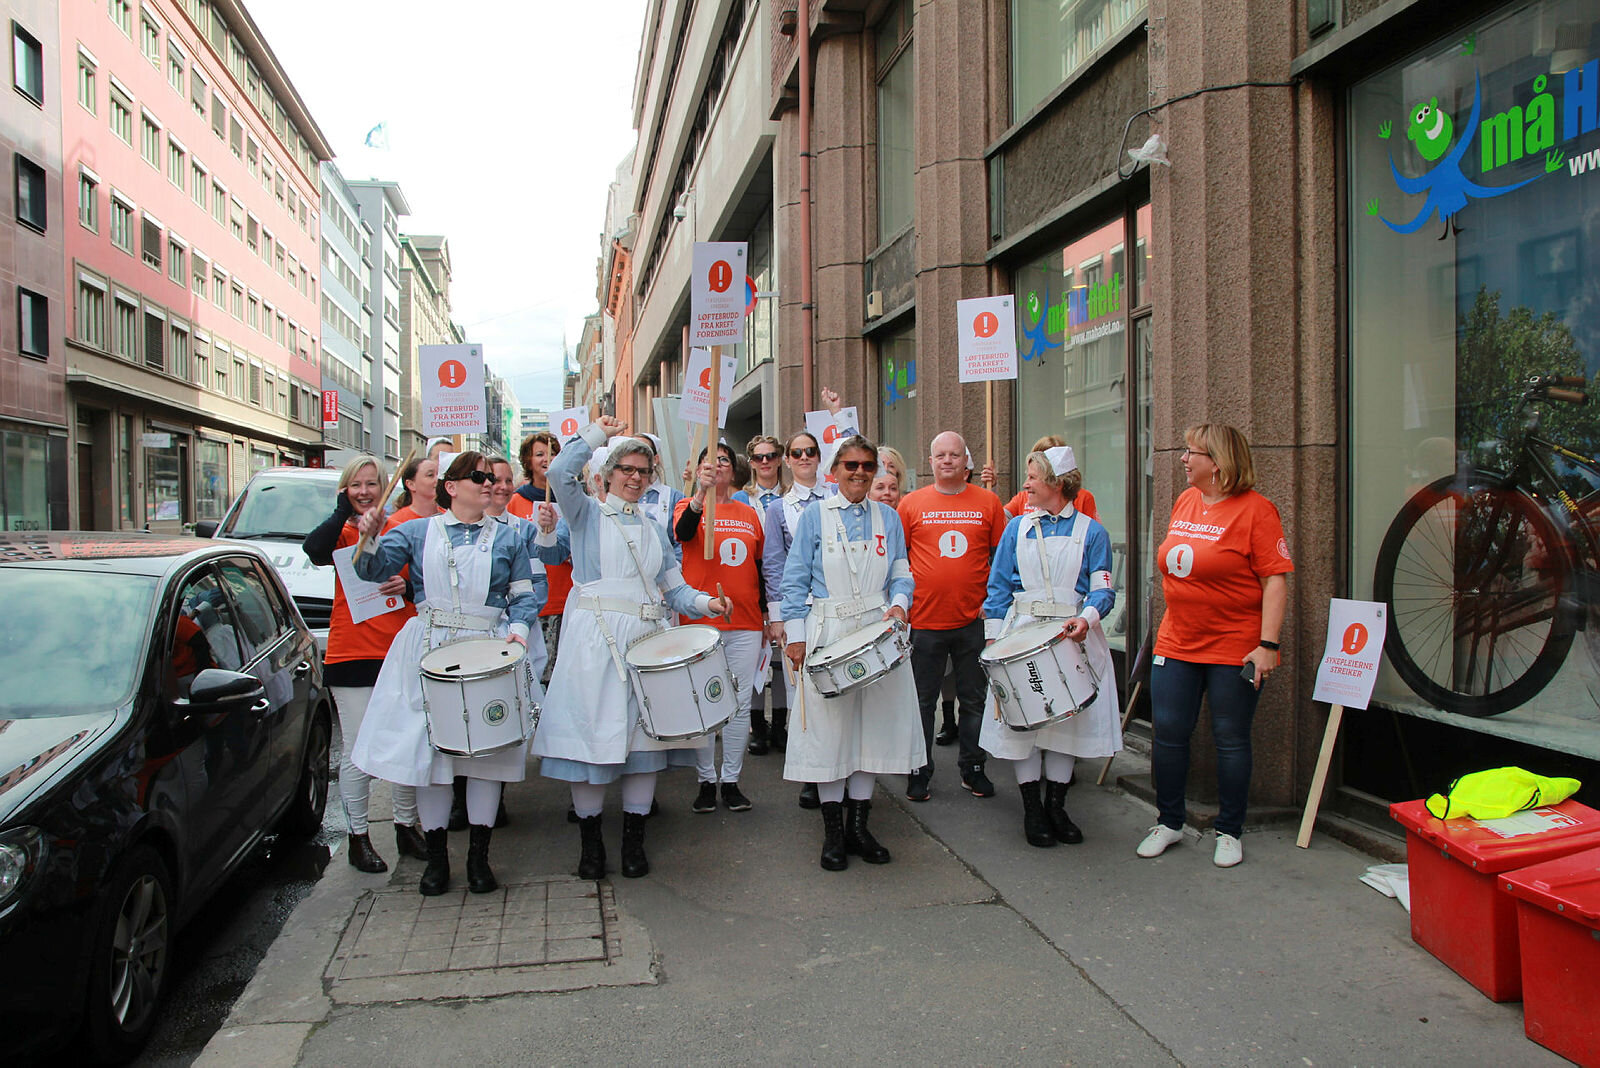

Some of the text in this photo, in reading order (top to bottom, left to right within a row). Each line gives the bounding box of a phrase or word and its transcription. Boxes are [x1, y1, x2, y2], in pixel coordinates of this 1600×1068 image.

[697, 311, 740, 321] LØFTEBRUDD
[700, 321, 714, 329] FRA
[696, 328, 738, 338] FORENINGEN
[965, 352, 1009, 362] LØFTEBRUDD
[968, 361, 982, 369] FRA
[965, 366, 1010, 375] FORENINGEN
[429, 404, 480, 414] LØFTEBRUDD
[430, 419, 480, 428] FORENINGEN
[922, 511, 983, 519] LØFTEBRUDD
[14, 520, 40, 531] STUDIO
[1171, 520, 1227, 535] LØFTEBRUDD
[1325, 656, 1374, 671] SYKEPLEIERNE
[1329, 666, 1363, 677] STREIKER
